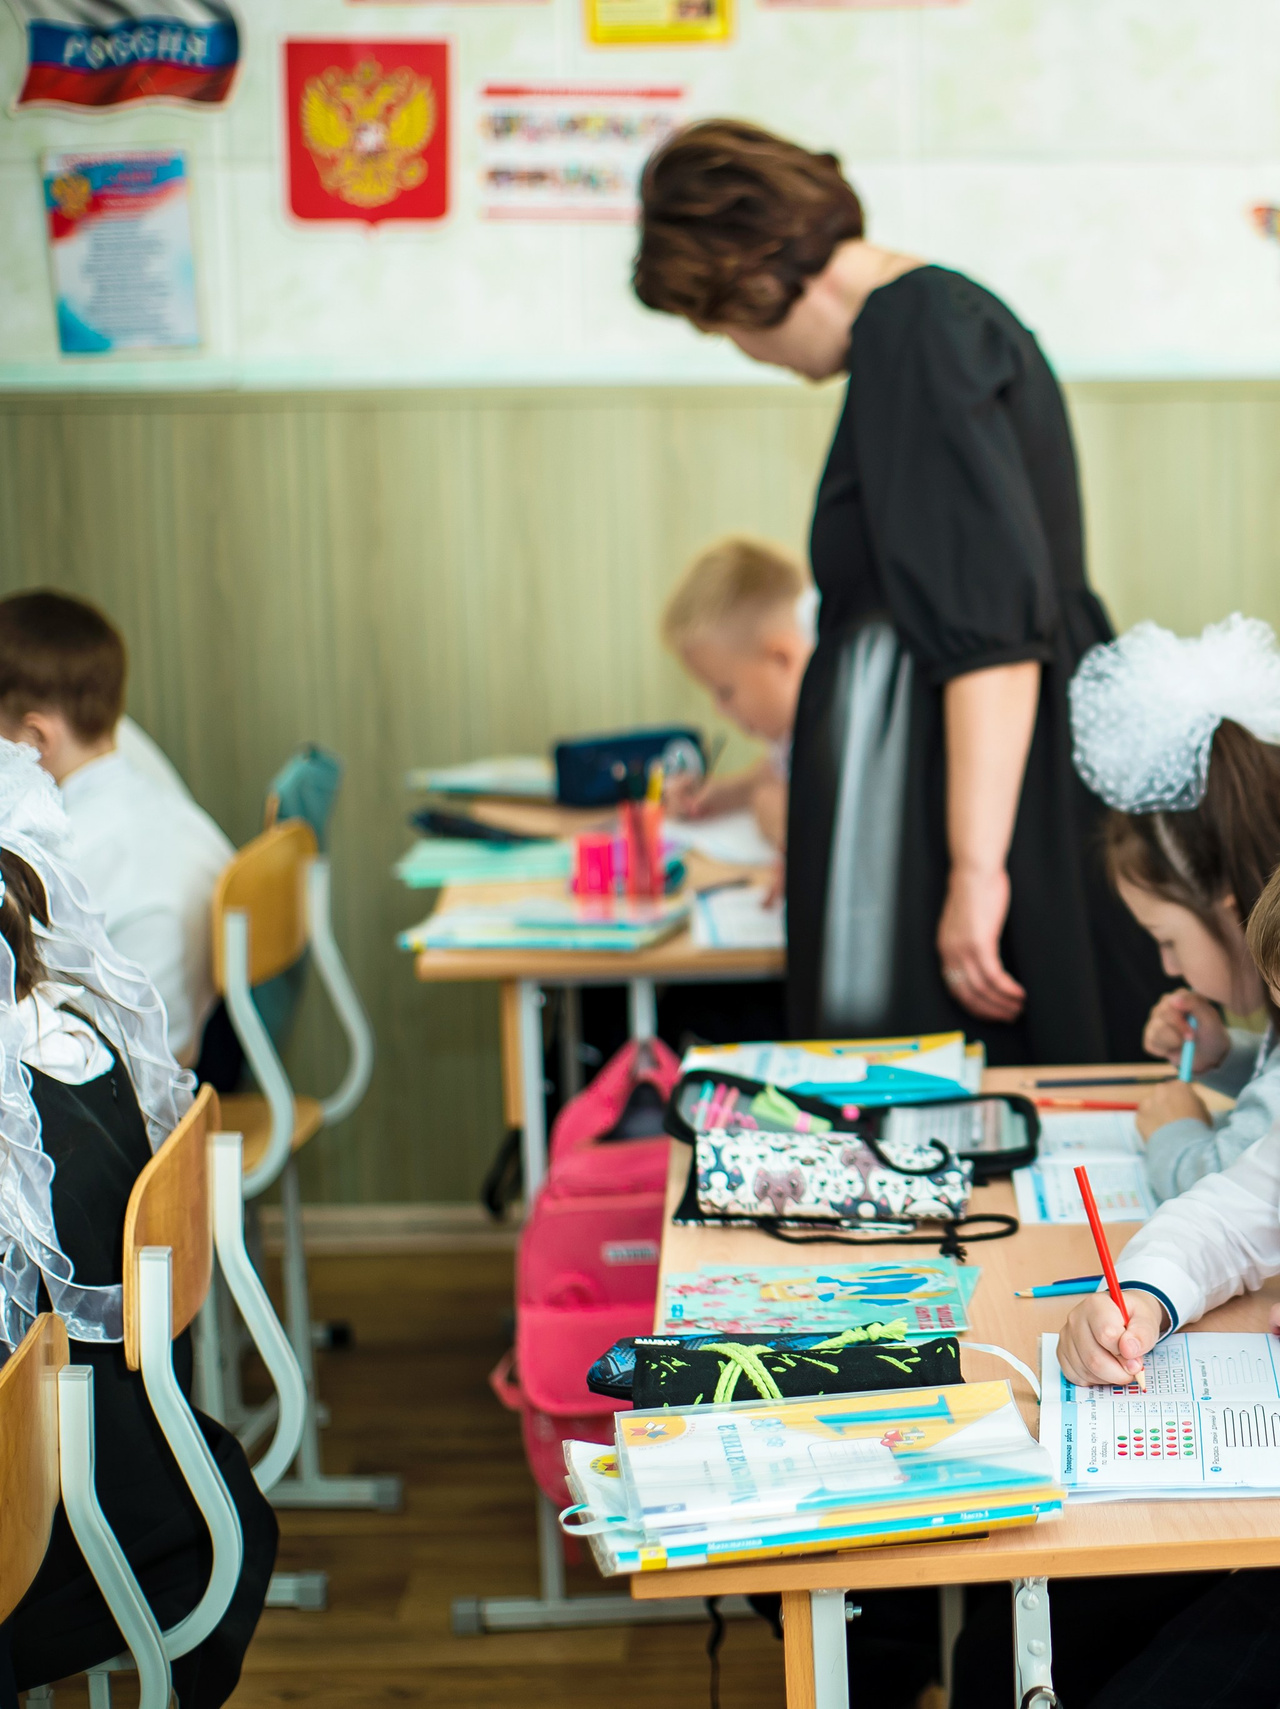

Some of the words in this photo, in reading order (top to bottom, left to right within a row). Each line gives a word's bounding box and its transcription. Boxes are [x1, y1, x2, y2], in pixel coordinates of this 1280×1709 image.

[63, 27, 207, 69] РОССИЯ
[1064, 1428, 1074, 1443] работа
[1064, 1444, 1074, 1474] Проверочная
